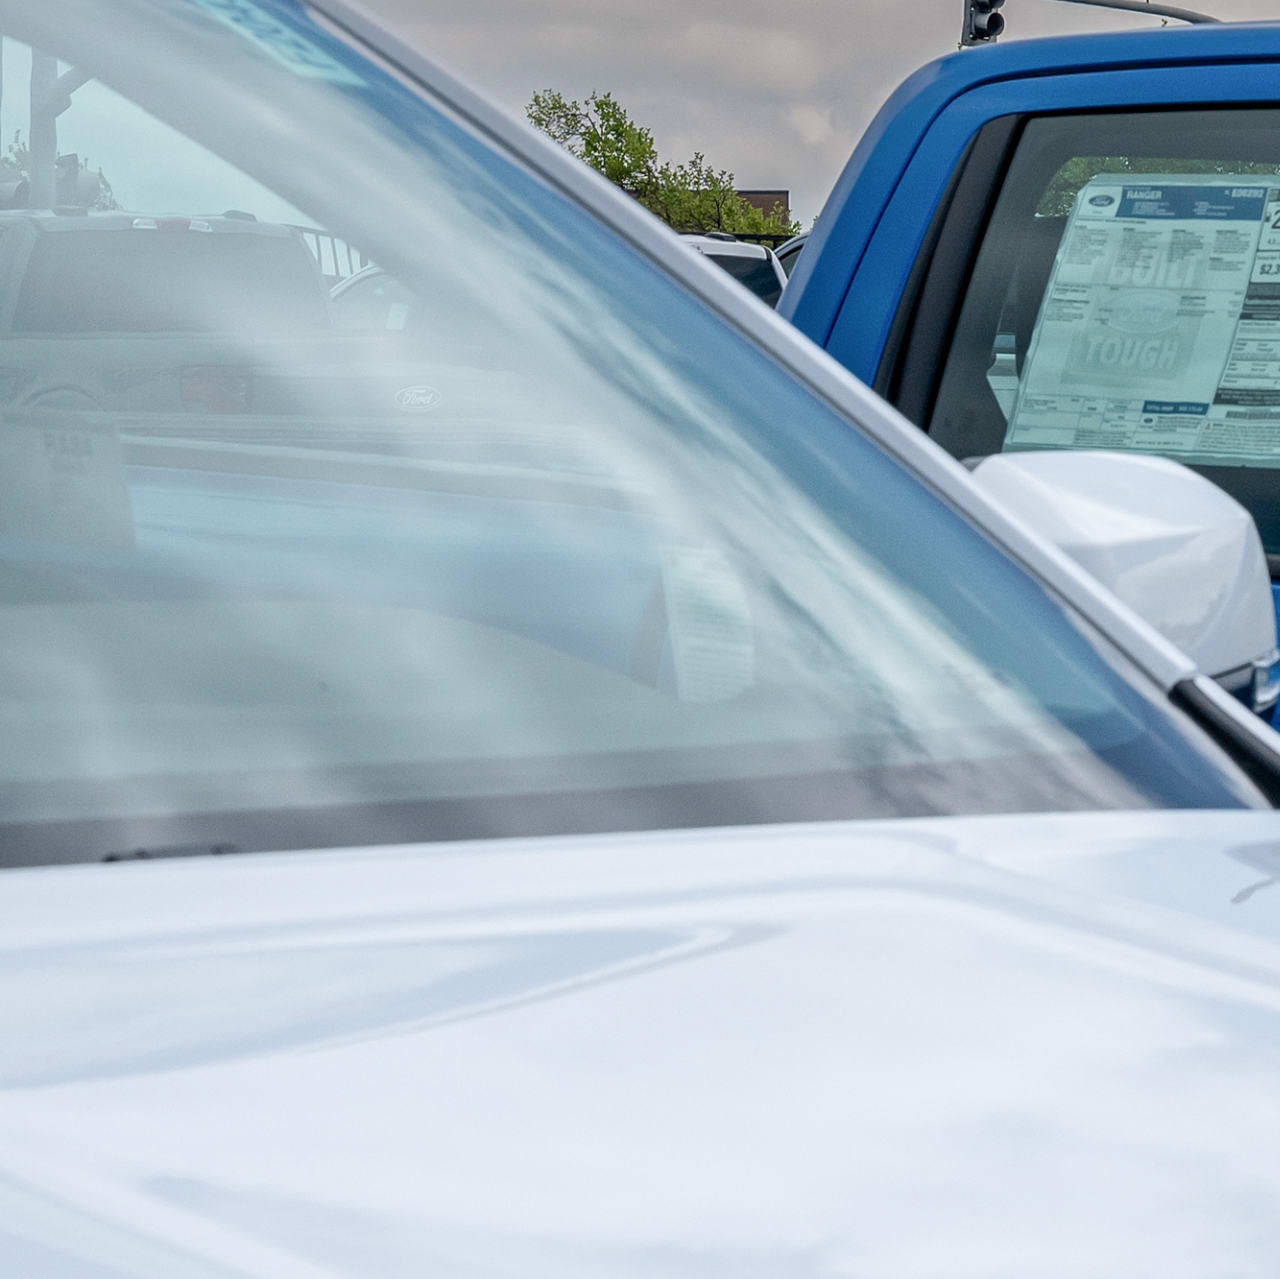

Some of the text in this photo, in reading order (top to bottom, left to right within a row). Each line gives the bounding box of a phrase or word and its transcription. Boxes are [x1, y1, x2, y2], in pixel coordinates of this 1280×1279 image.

[1126, 190, 1162, 200] RANGER
[1085, 335, 1180, 370] TOUGH
[402, 388, 434, 405] Ford
